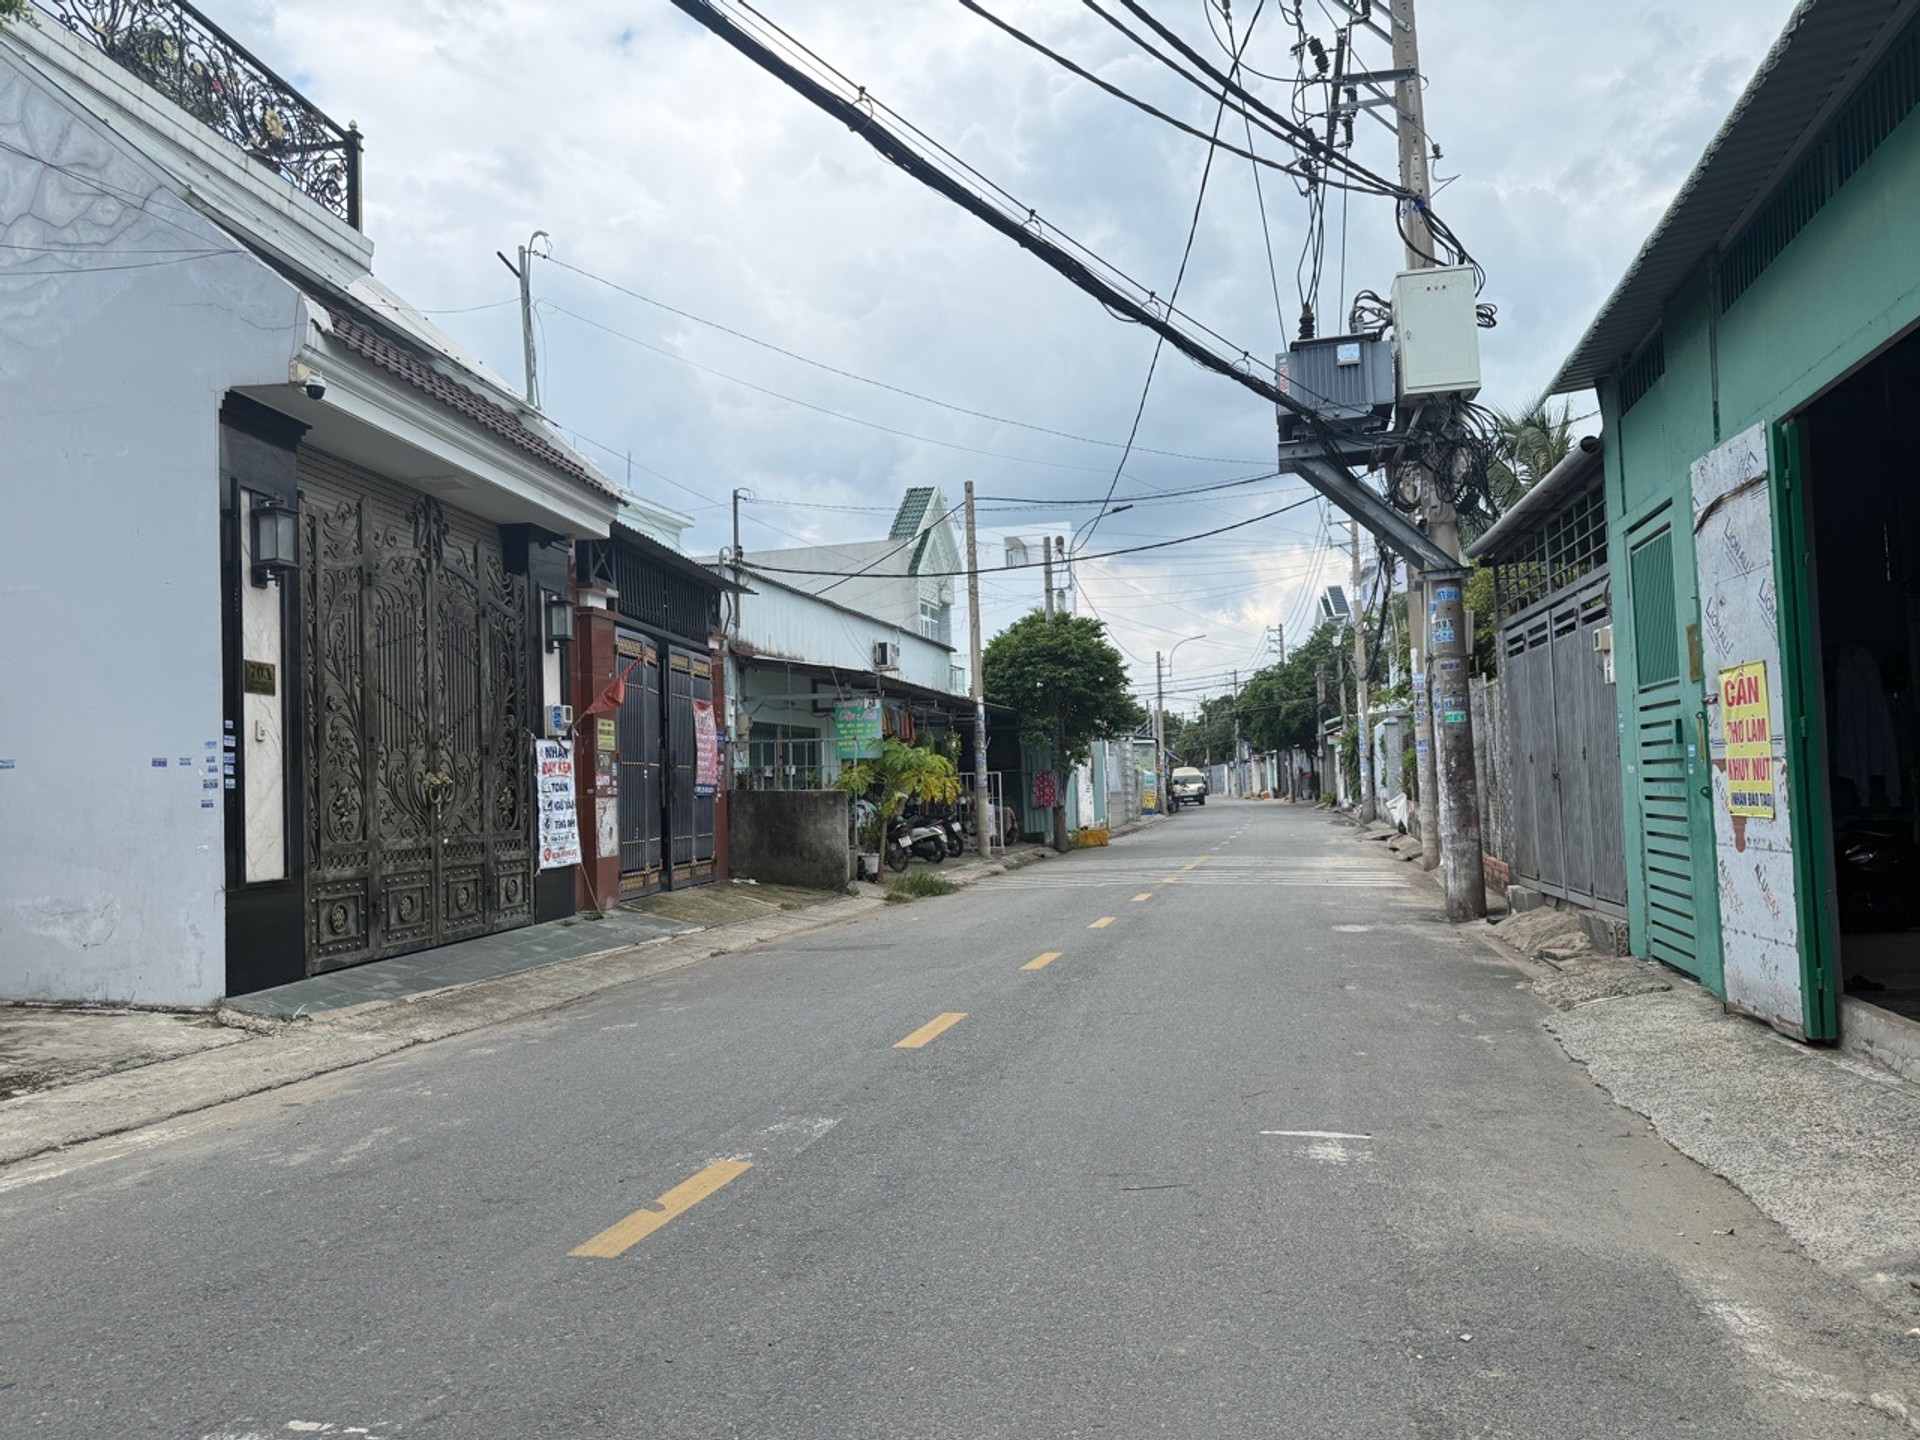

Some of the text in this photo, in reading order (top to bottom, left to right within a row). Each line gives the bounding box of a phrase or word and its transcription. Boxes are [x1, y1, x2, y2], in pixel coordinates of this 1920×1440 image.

[1724, 671, 1760, 707] CẦN
[1727, 714, 1767, 749] THỢ LÀM
[1752, 752, 1771, 781] NÚT
